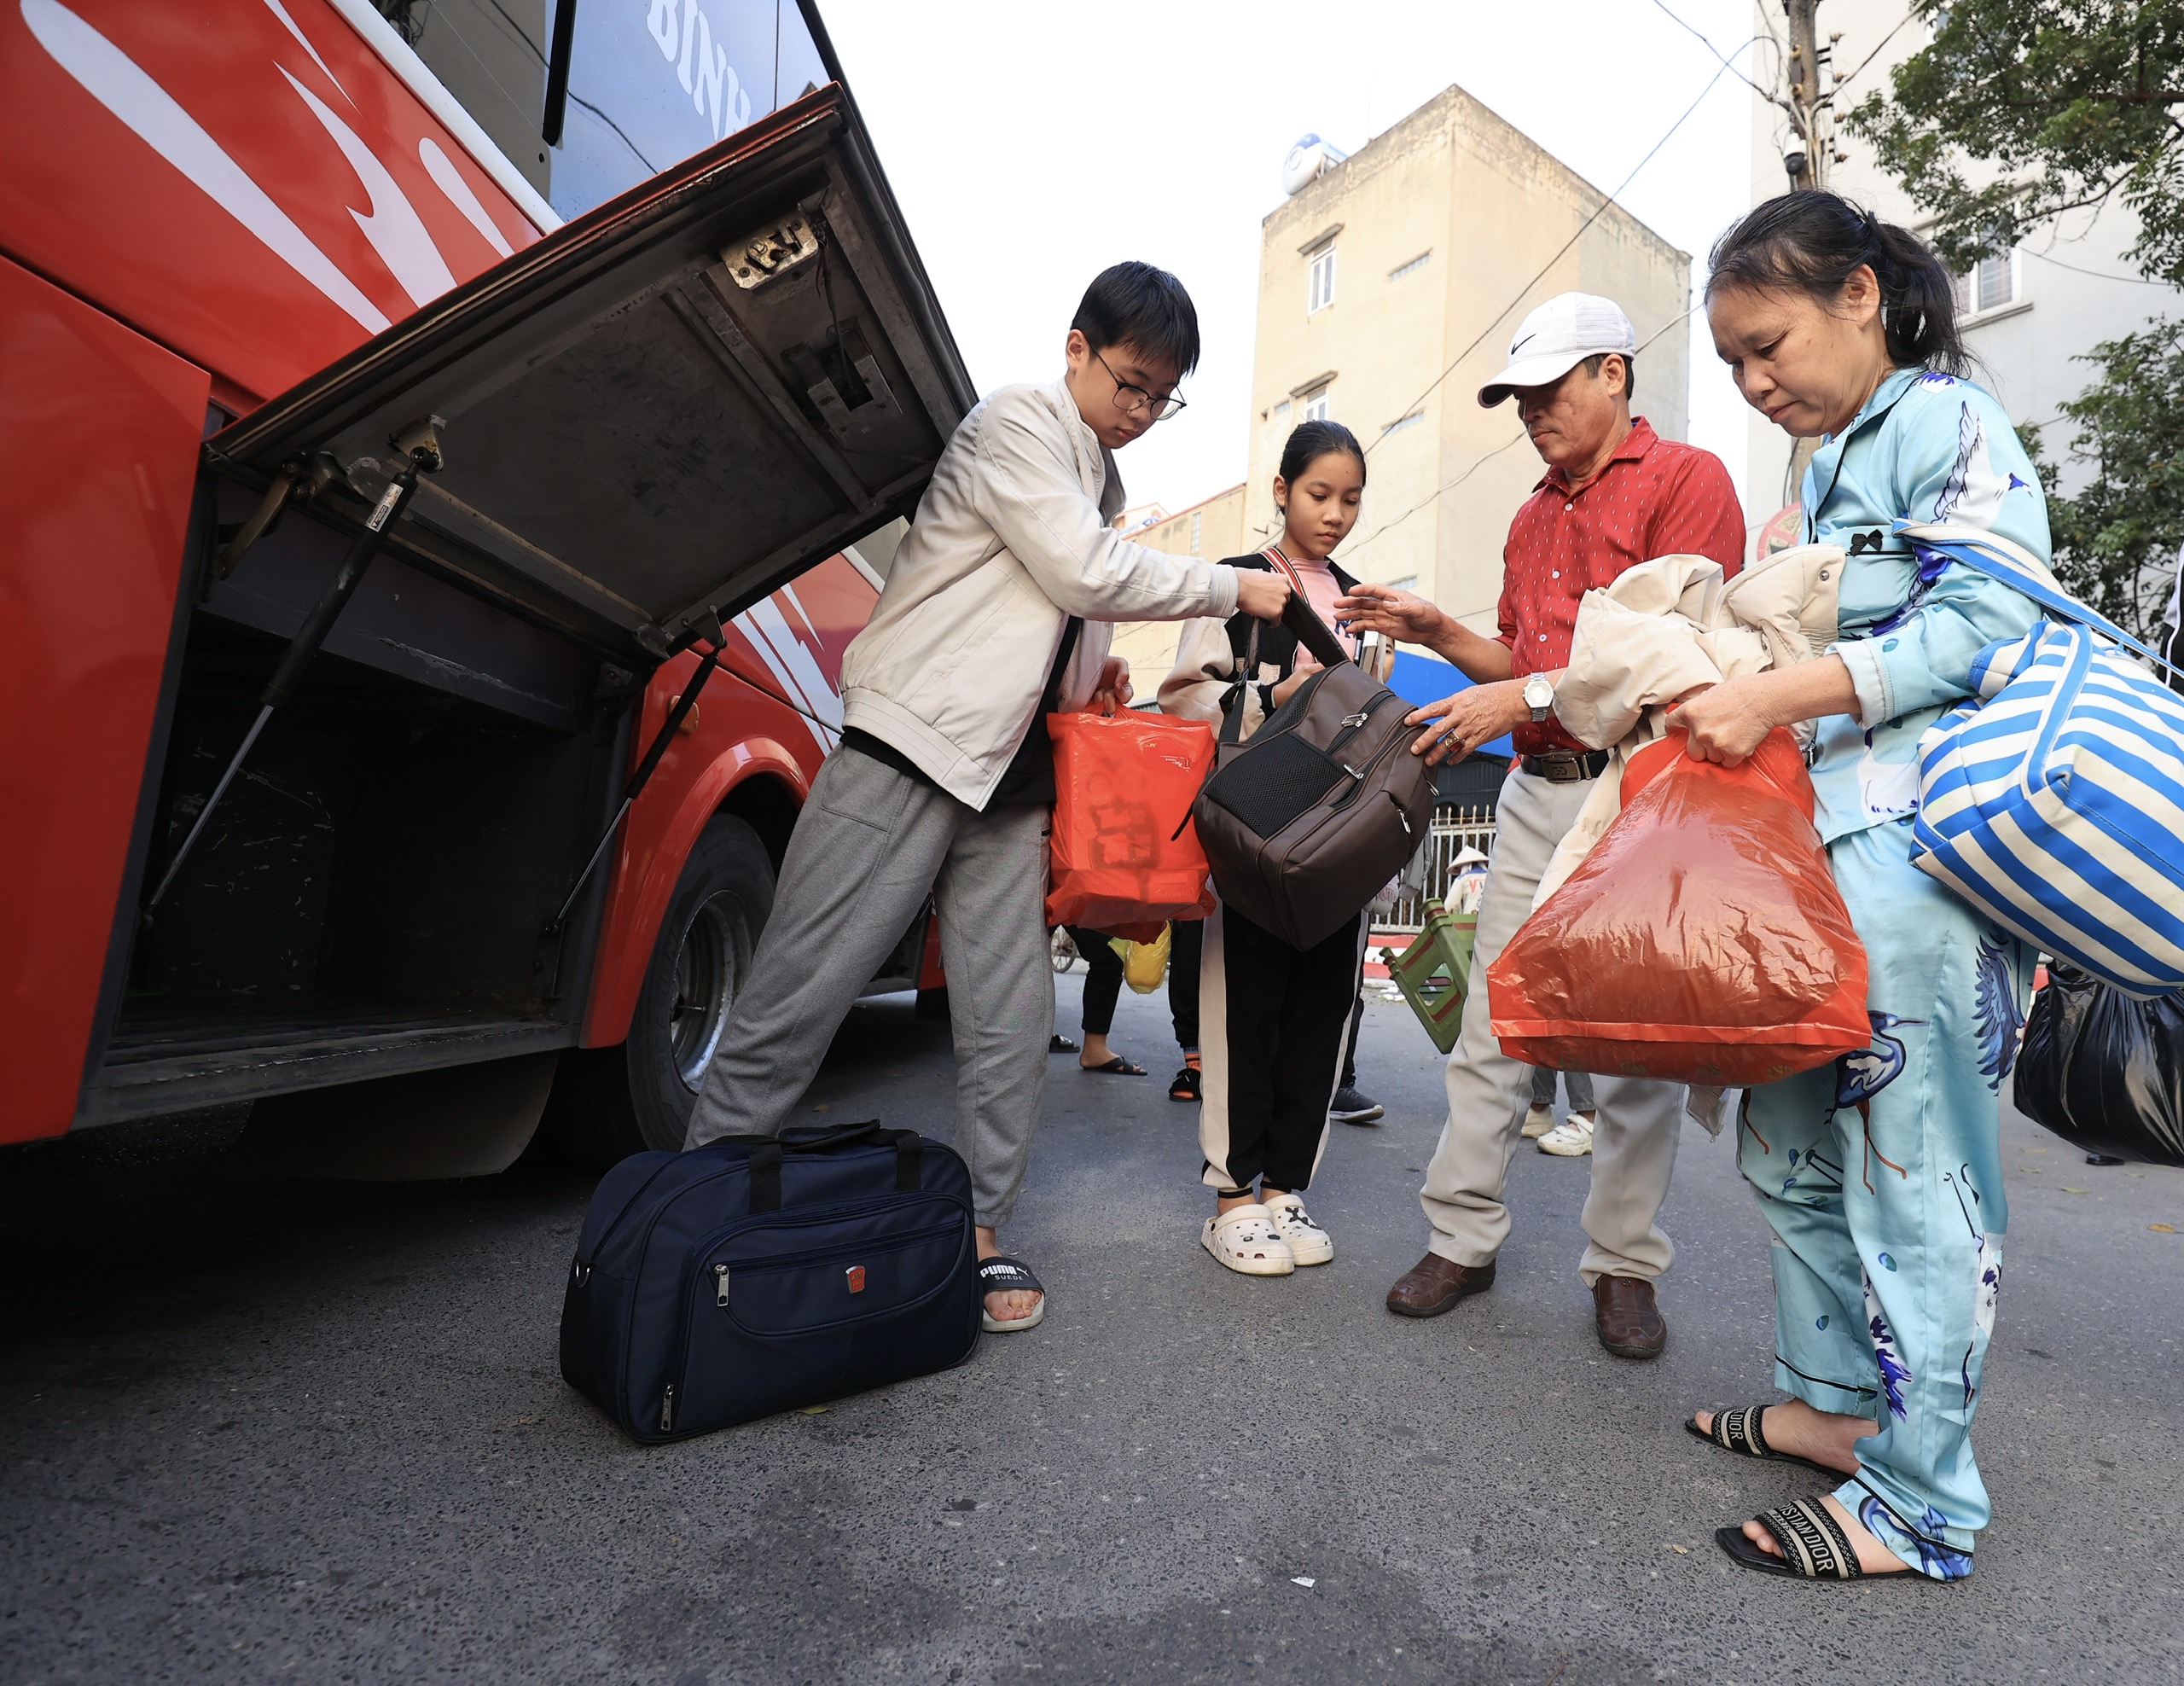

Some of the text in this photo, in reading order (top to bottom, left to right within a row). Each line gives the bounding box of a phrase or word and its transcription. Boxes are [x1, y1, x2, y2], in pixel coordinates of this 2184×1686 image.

[979, 1264, 1017, 1278] PUMA
[1728, 1414, 1744, 1439] DIOR
[1773, 1513, 1792, 1531] PARIS
[1804, 1534, 1834, 1572] DIOR
